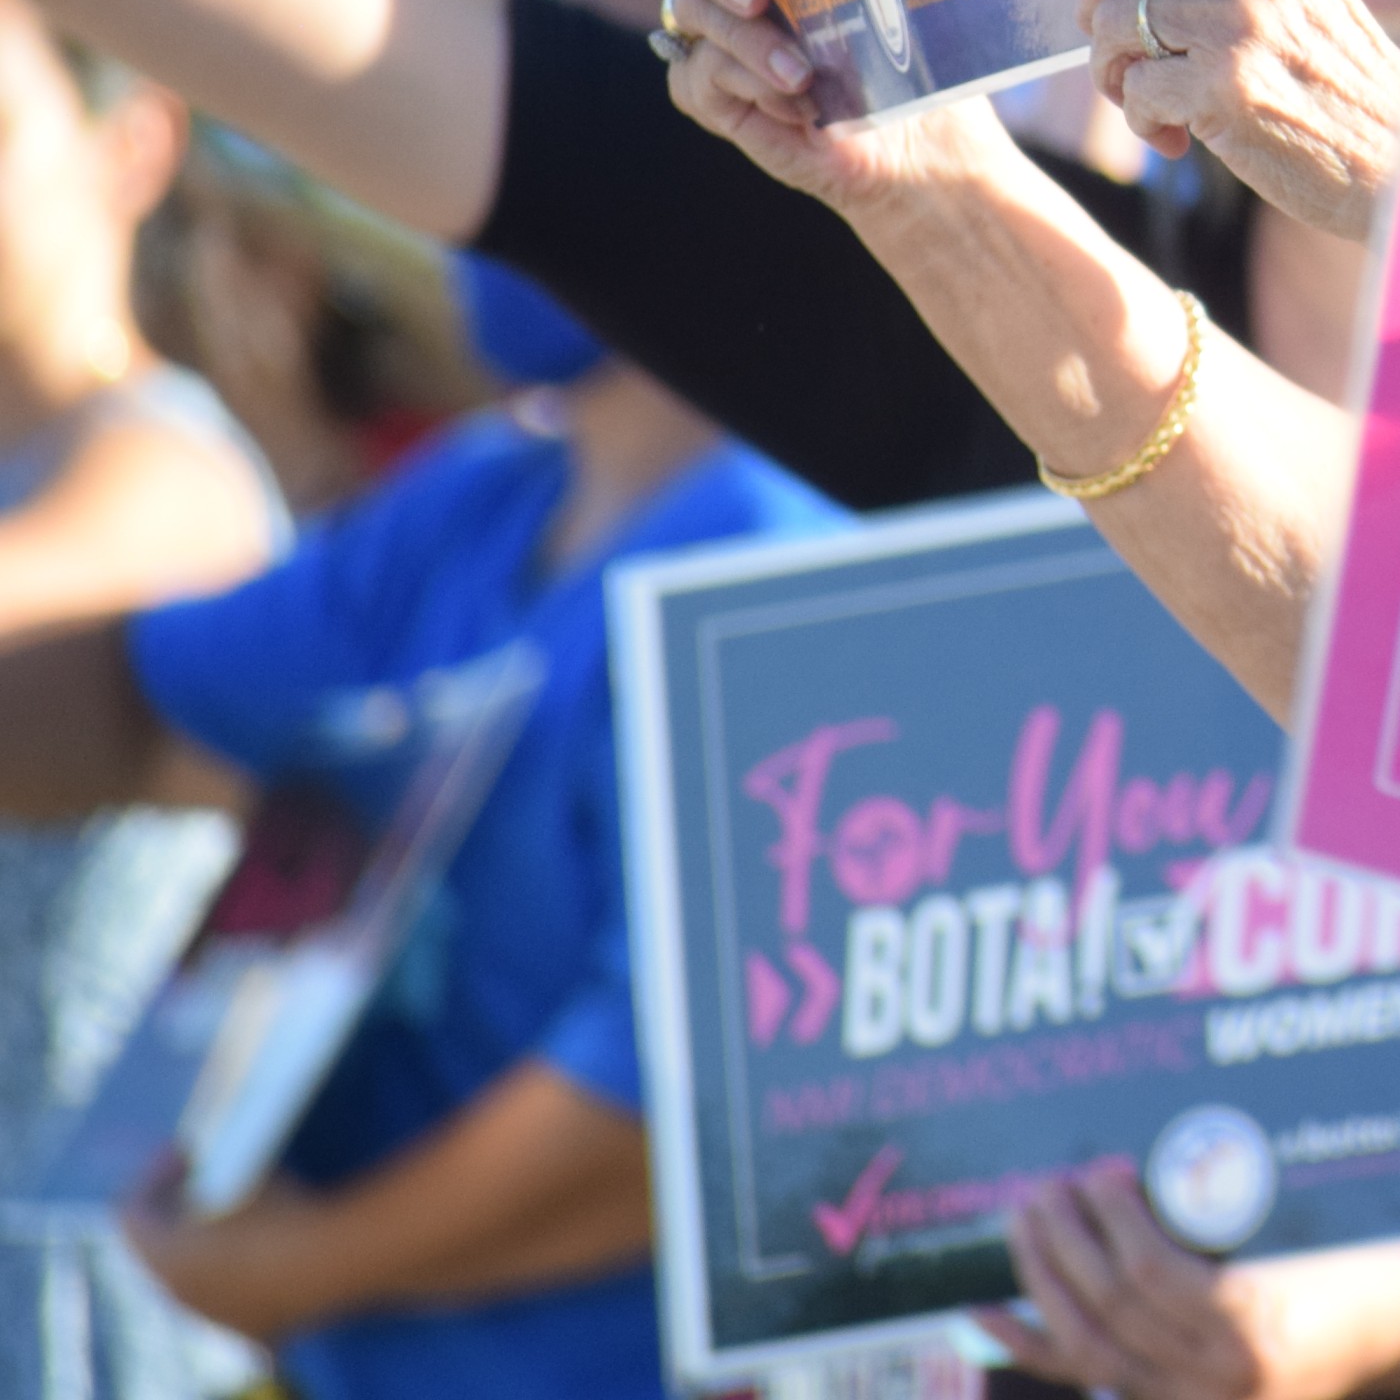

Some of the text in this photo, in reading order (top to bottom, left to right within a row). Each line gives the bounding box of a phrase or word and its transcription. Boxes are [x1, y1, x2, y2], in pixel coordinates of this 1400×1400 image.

[743, 715, 1008, 938] For
[1006, 703, 1276, 942] You
[839, 864, 1120, 1061] BOTA!
